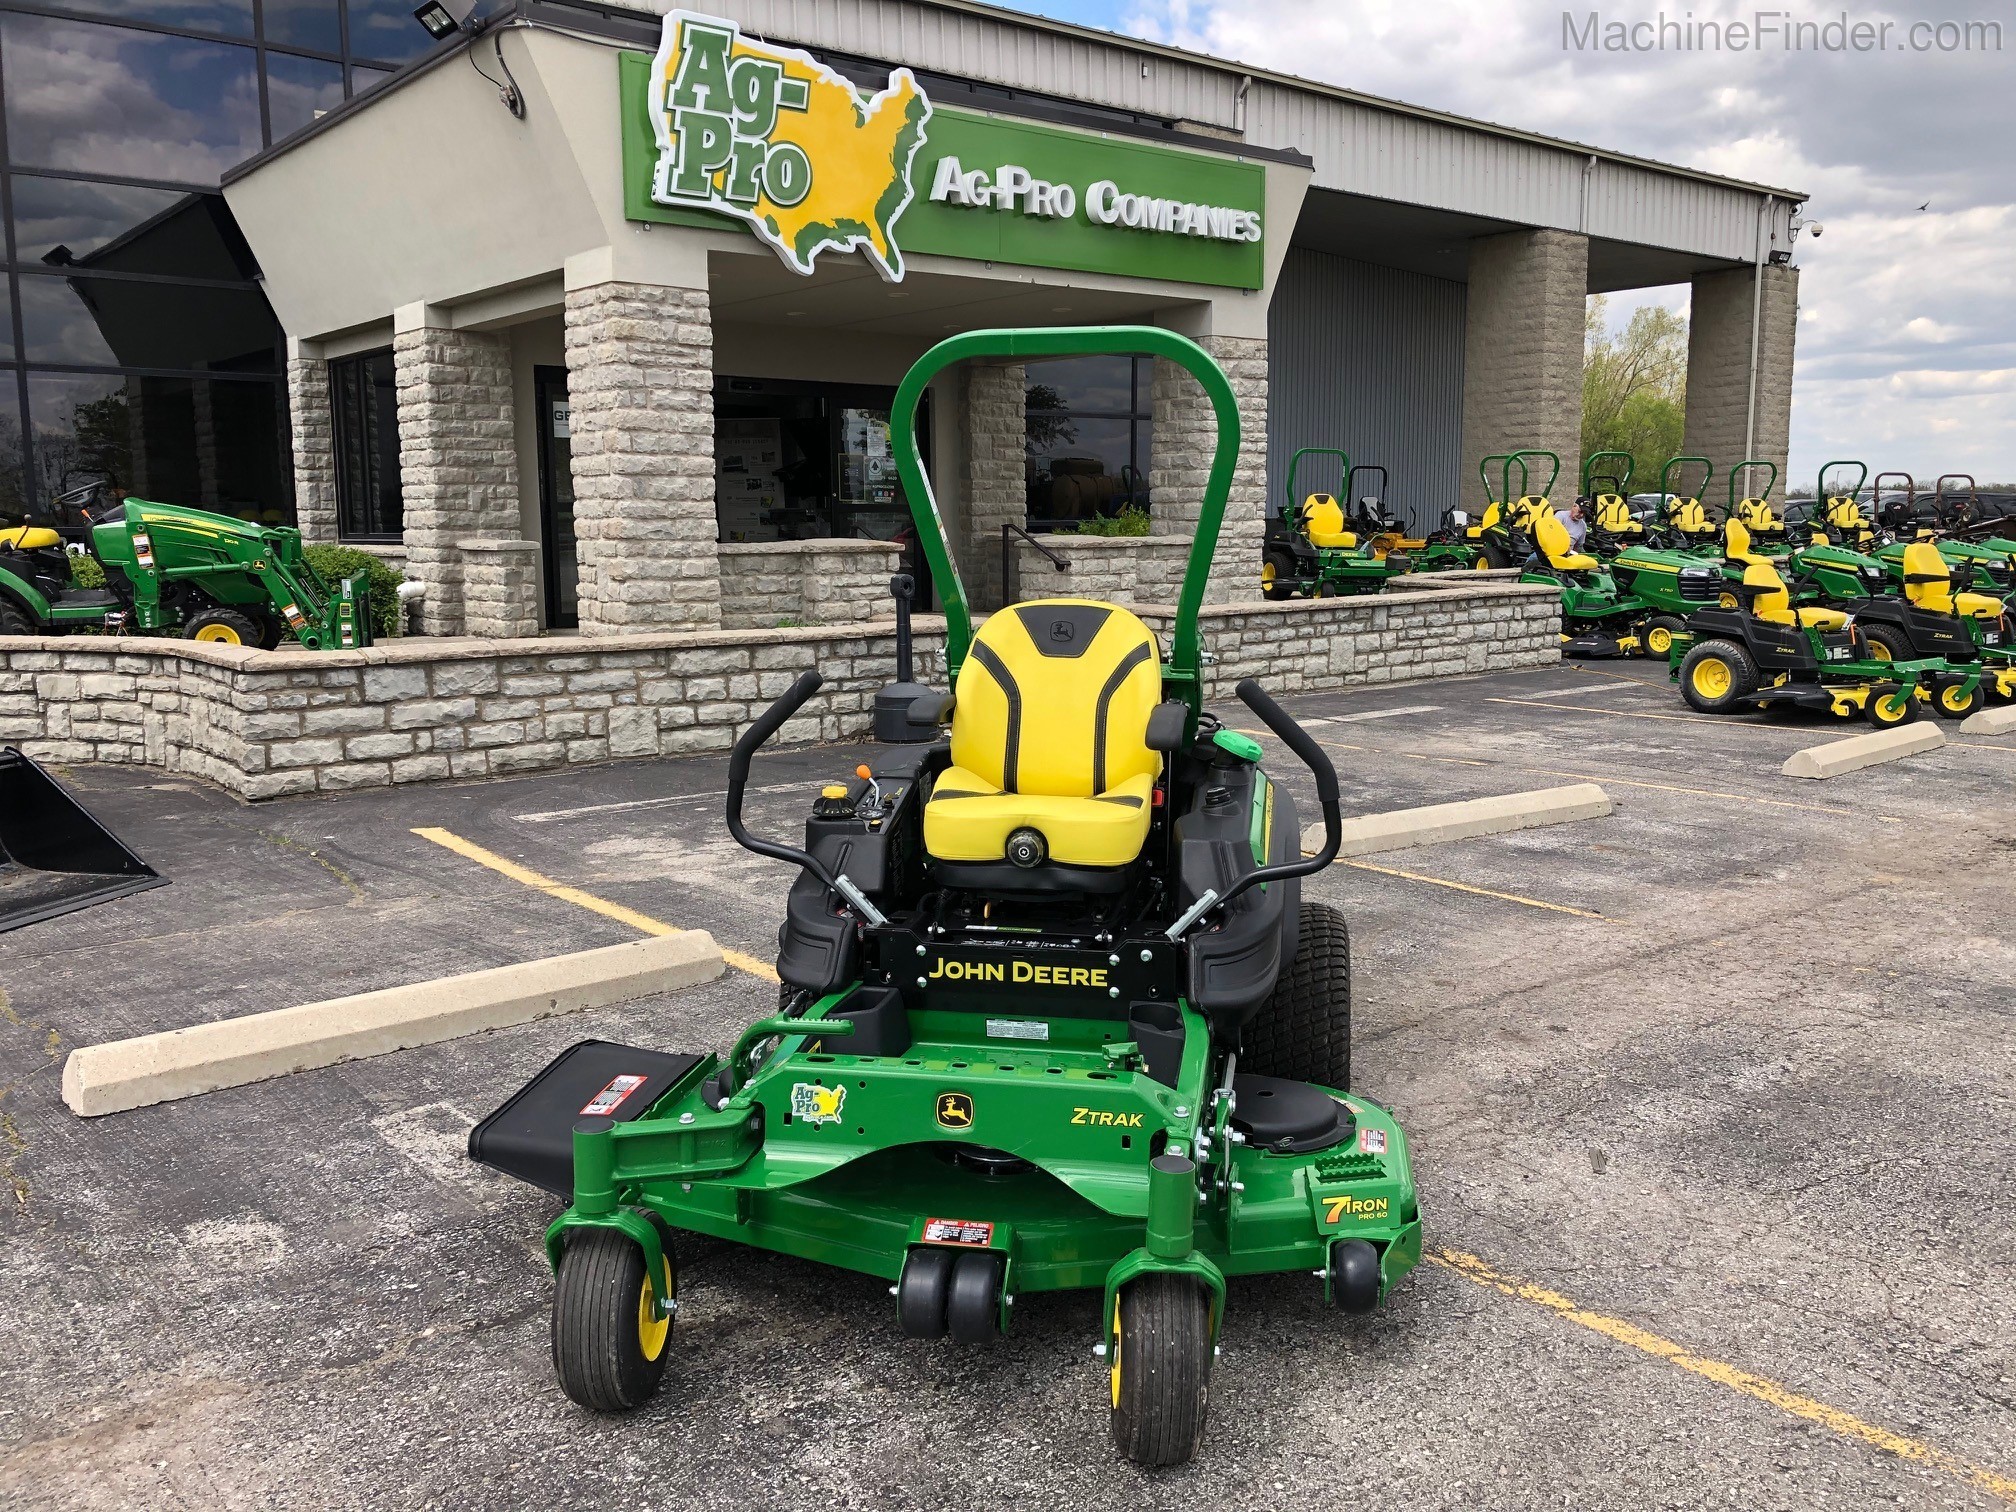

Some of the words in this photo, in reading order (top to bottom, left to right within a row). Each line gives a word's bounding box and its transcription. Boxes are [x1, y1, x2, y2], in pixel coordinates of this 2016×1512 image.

[667, 21, 810, 140] Ag-
[670, 110, 812, 207] Pro
[930, 155, 1075, 218] AG-PRO
[1086, 180, 1262, 243] COMPANIES
[929, 957, 1004, 981] JOHN
[1012, 961, 1108, 987] DEERE
[796, 1100, 820, 1112] Pro
[1070, 1107, 1144, 1127] ZTRAK
[1358, 1213, 1375, 1221] PRO
[1376, 1211, 1388, 1219] 60
